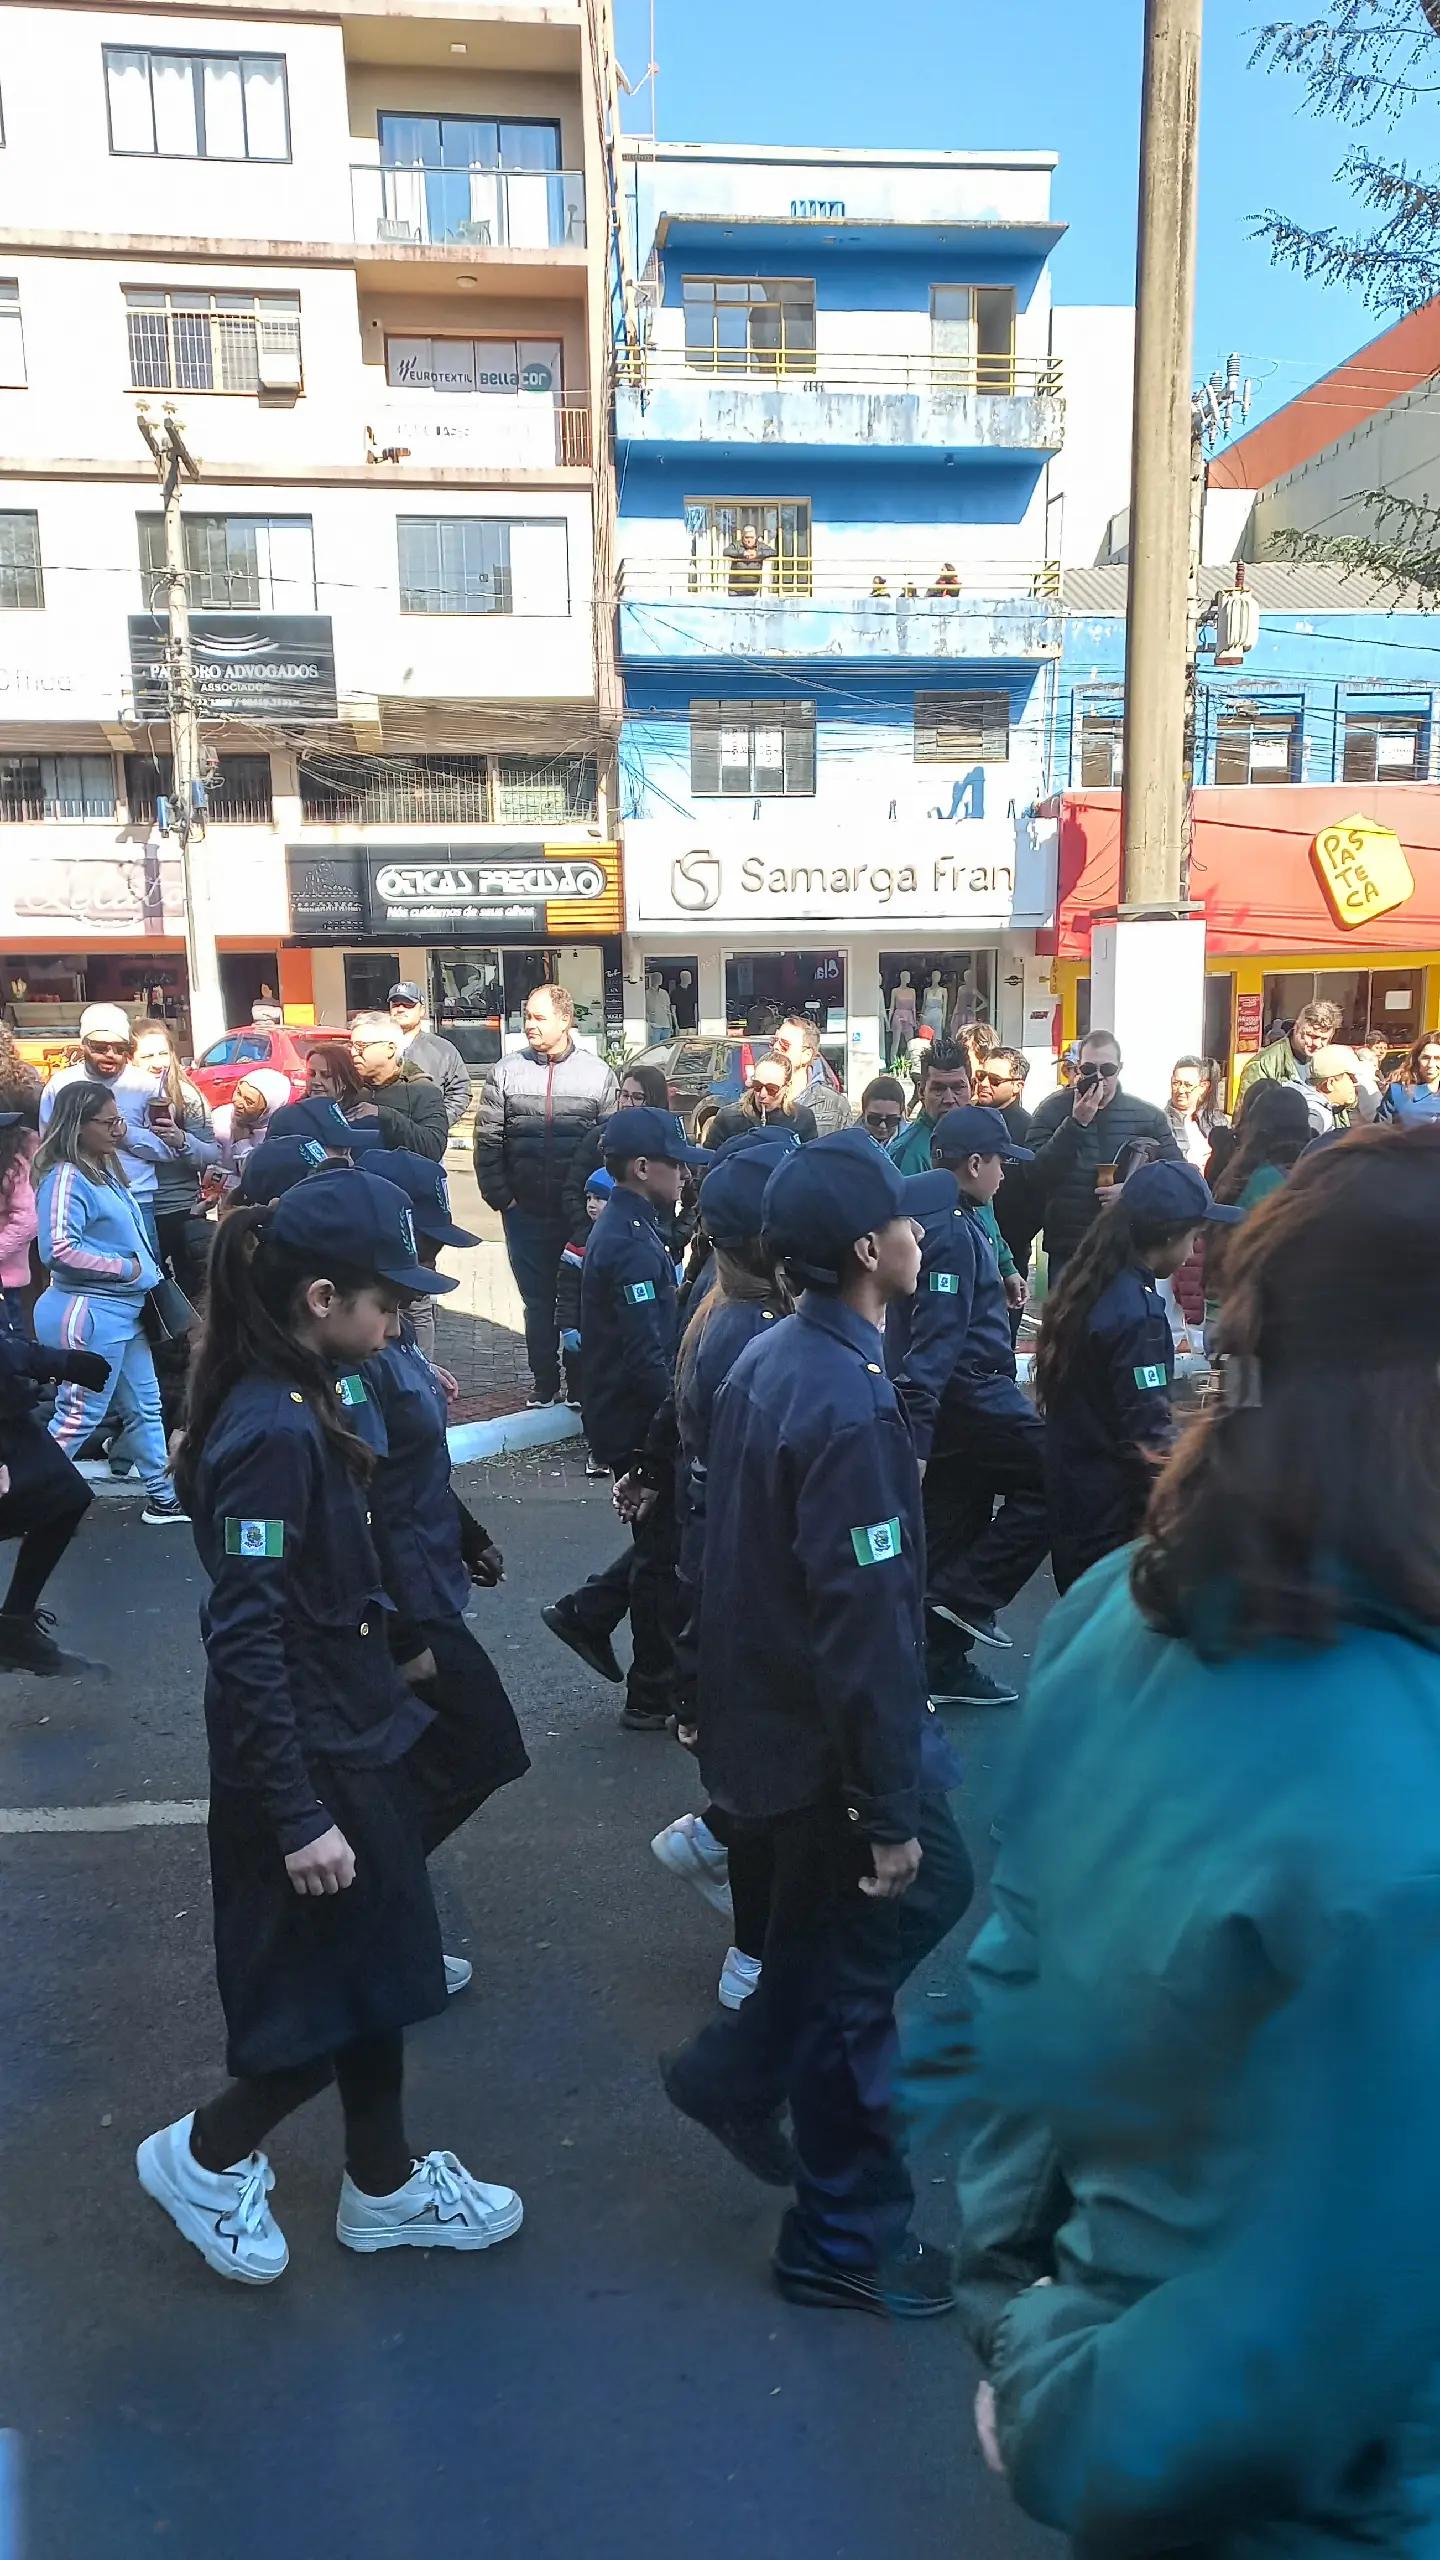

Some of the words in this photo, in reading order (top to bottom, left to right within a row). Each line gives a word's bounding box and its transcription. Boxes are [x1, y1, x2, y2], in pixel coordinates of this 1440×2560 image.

[224, 663, 320, 679] ADVOGADOS
[741, 856, 918, 903] Samarga
[463, 904, 478, 917] de
[479, 907, 503, 917] seus
[506, 904, 535, 917] olhos
